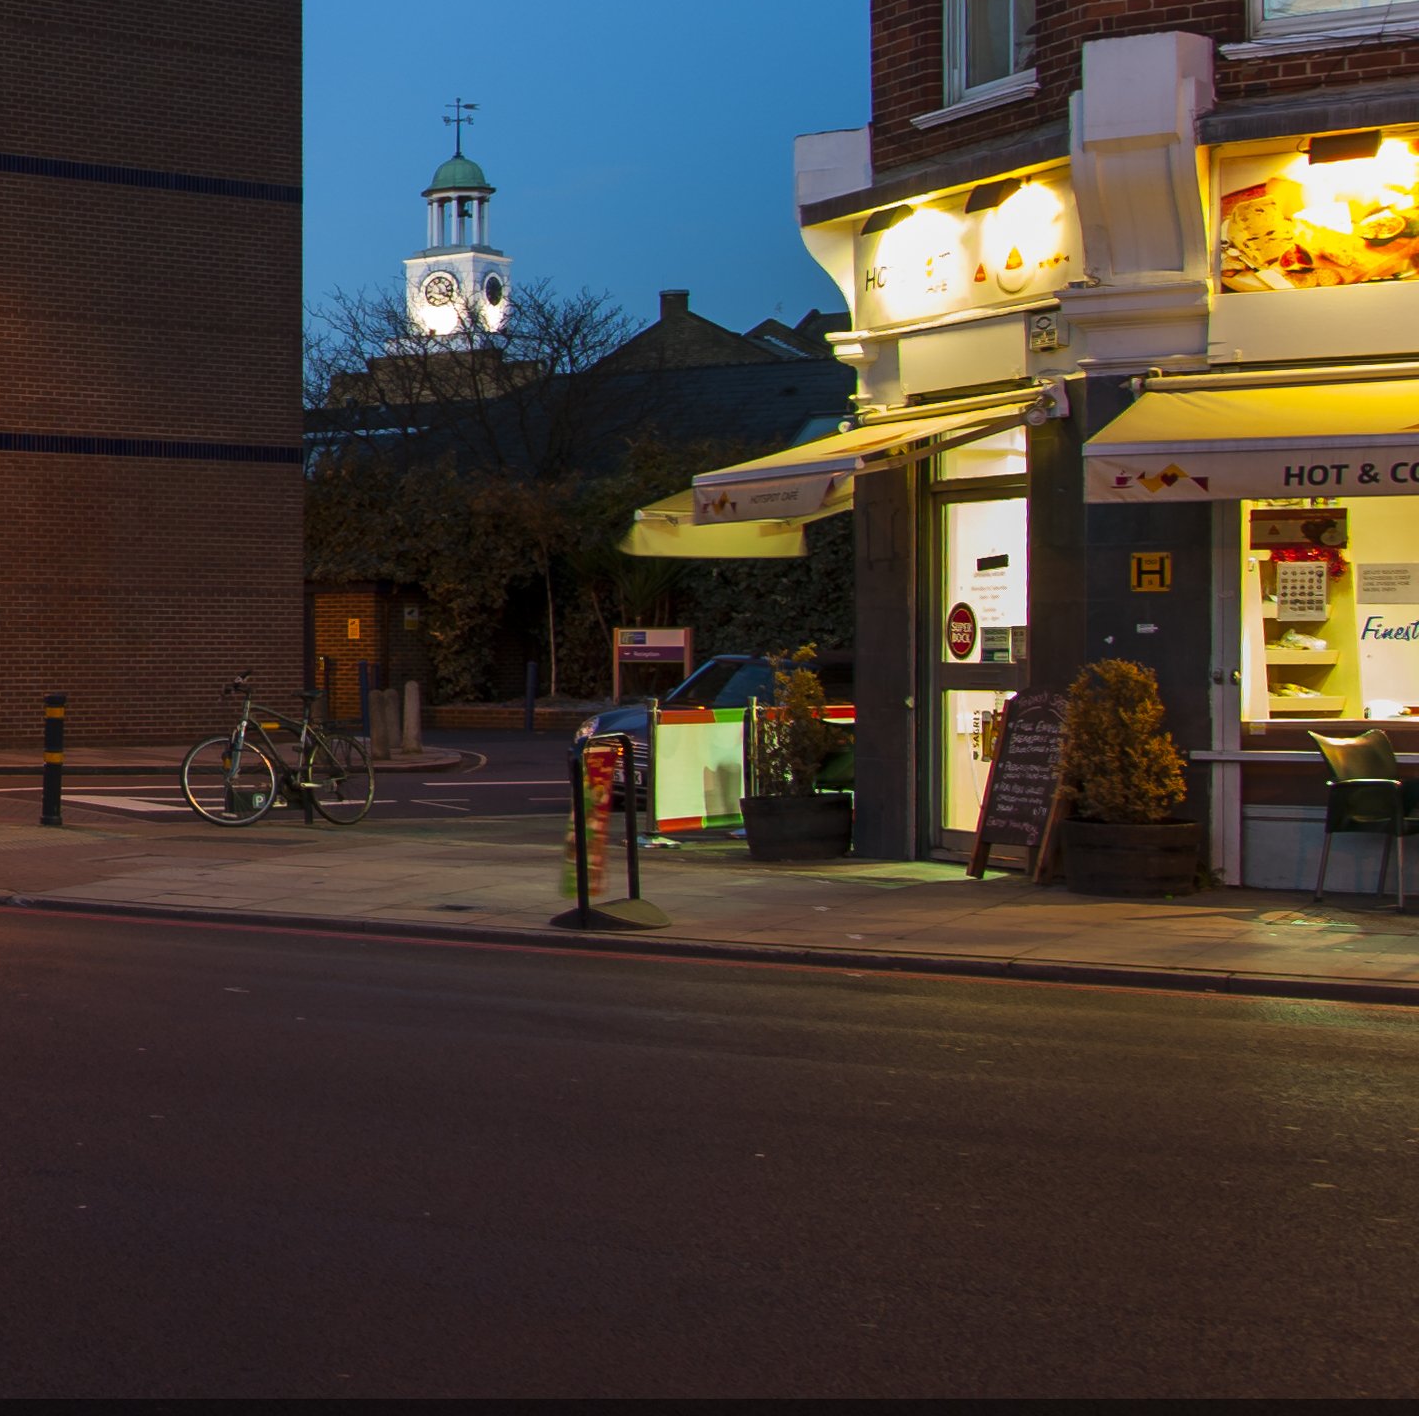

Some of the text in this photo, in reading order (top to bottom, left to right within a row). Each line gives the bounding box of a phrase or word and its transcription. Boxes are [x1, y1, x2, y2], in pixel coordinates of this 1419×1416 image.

[1284, 464, 1349, 487] HOT
[1357, 462, 1380, 484] &
[1137, 557, 1165, 588] H
[1360, 616, 1419, 642] Finest
